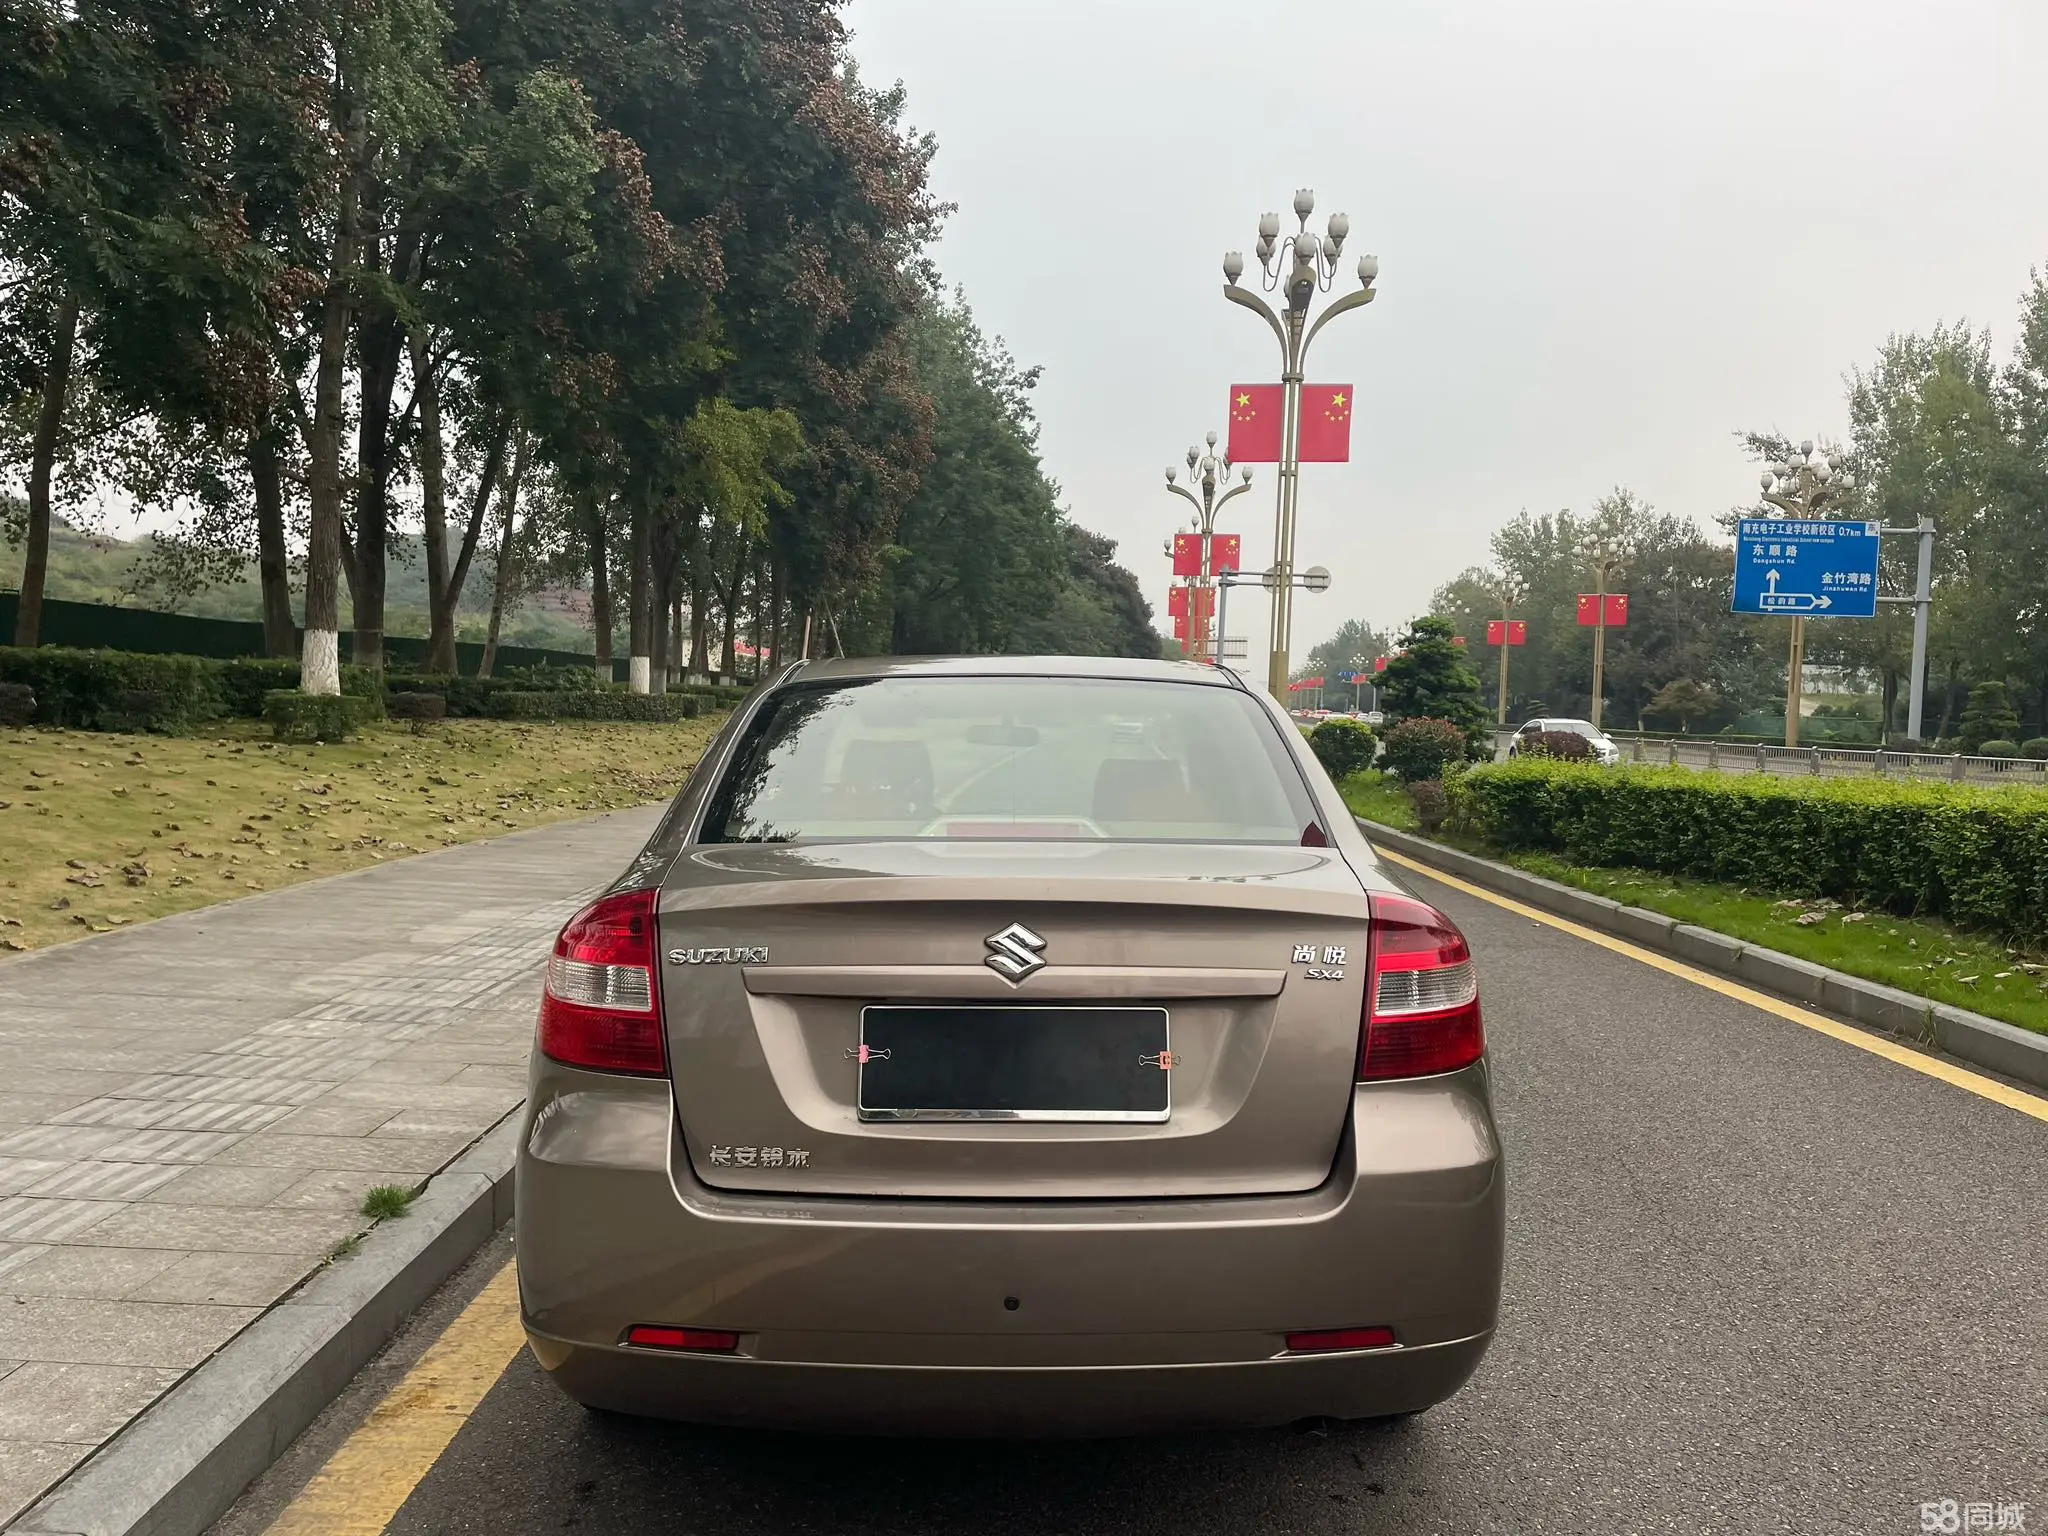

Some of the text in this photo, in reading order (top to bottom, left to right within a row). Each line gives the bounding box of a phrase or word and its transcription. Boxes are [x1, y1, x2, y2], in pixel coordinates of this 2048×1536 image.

[1743, 523, 1835, 536] 南充电子工业学校新校区
[1753, 544, 1797, 557] 东顺路
[1821, 572, 1871, 585] 金竹湾路
[668, 946, 769, 965] SUZUKI
[1291, 944, 1347, 965] 尚悦
[1304, 967, 1345, 981] SX4
[709, 1144, 811, 1168] 长安铃木
